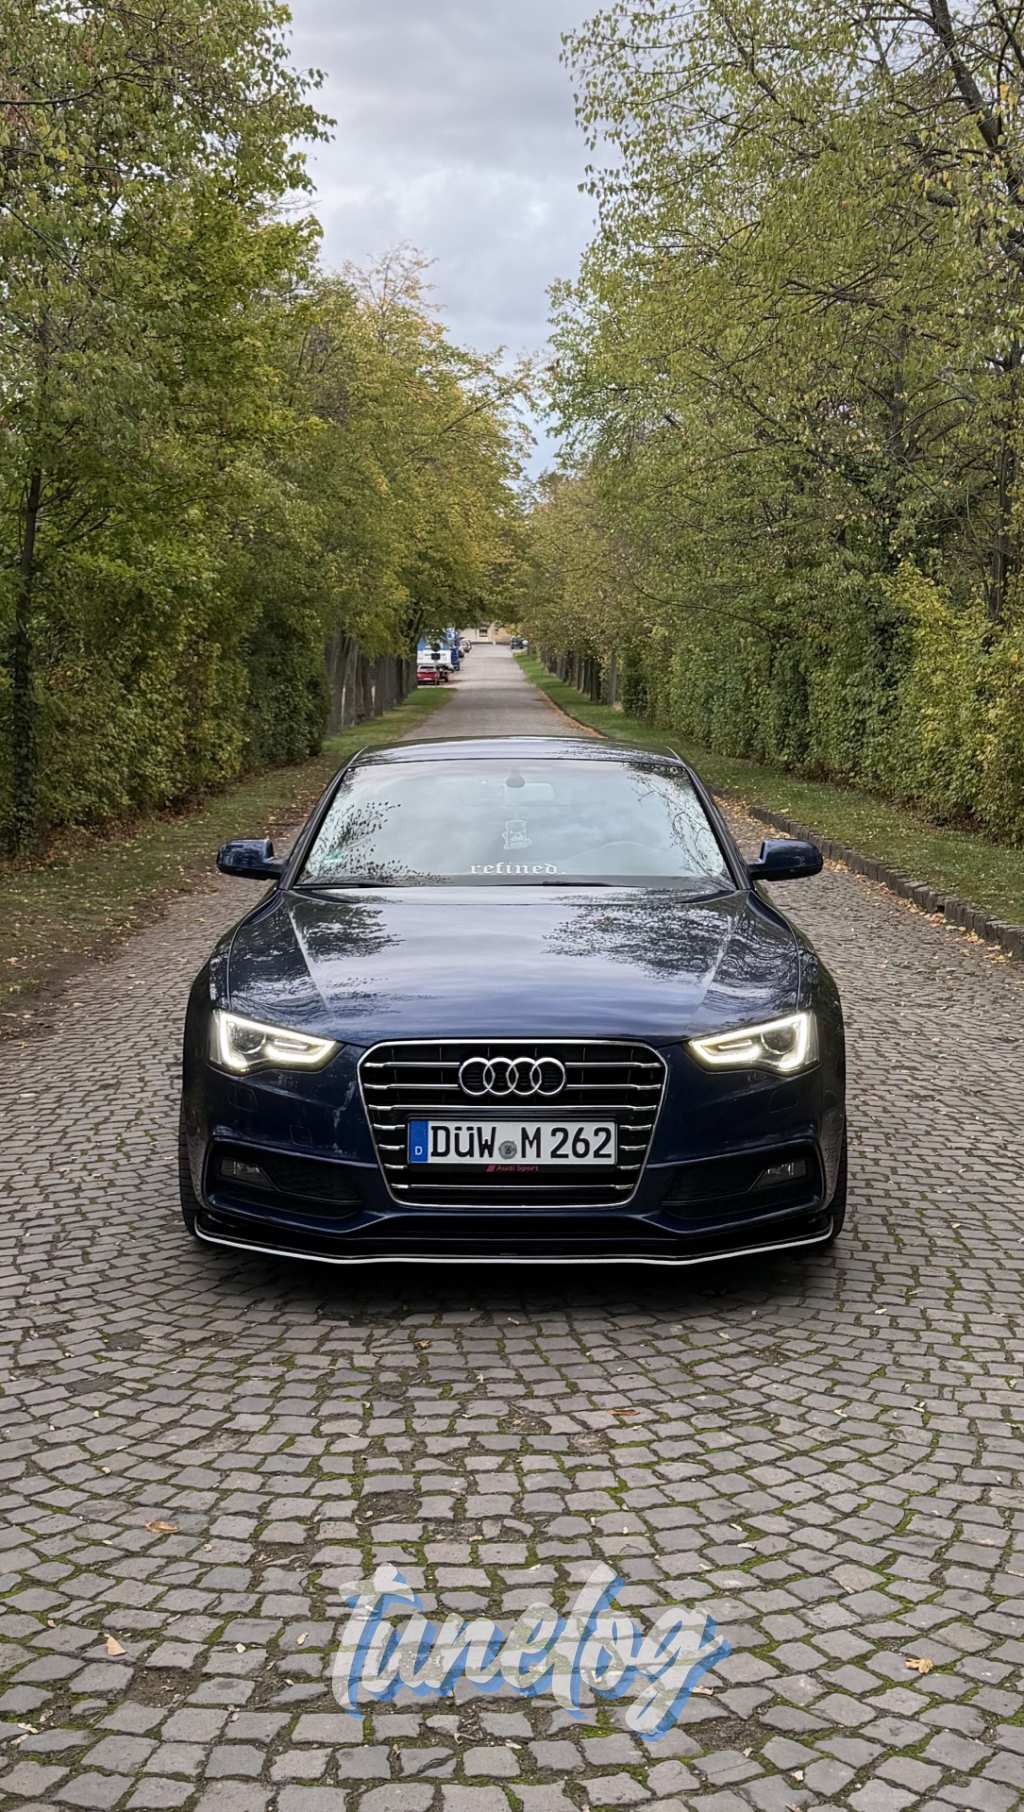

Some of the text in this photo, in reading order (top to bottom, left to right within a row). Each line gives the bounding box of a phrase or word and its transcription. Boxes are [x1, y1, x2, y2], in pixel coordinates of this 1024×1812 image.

[471, 862, 566, 875] refined.
[550, 1126, 612, 1159] 262
[414, 1146, 423, 1156] D
